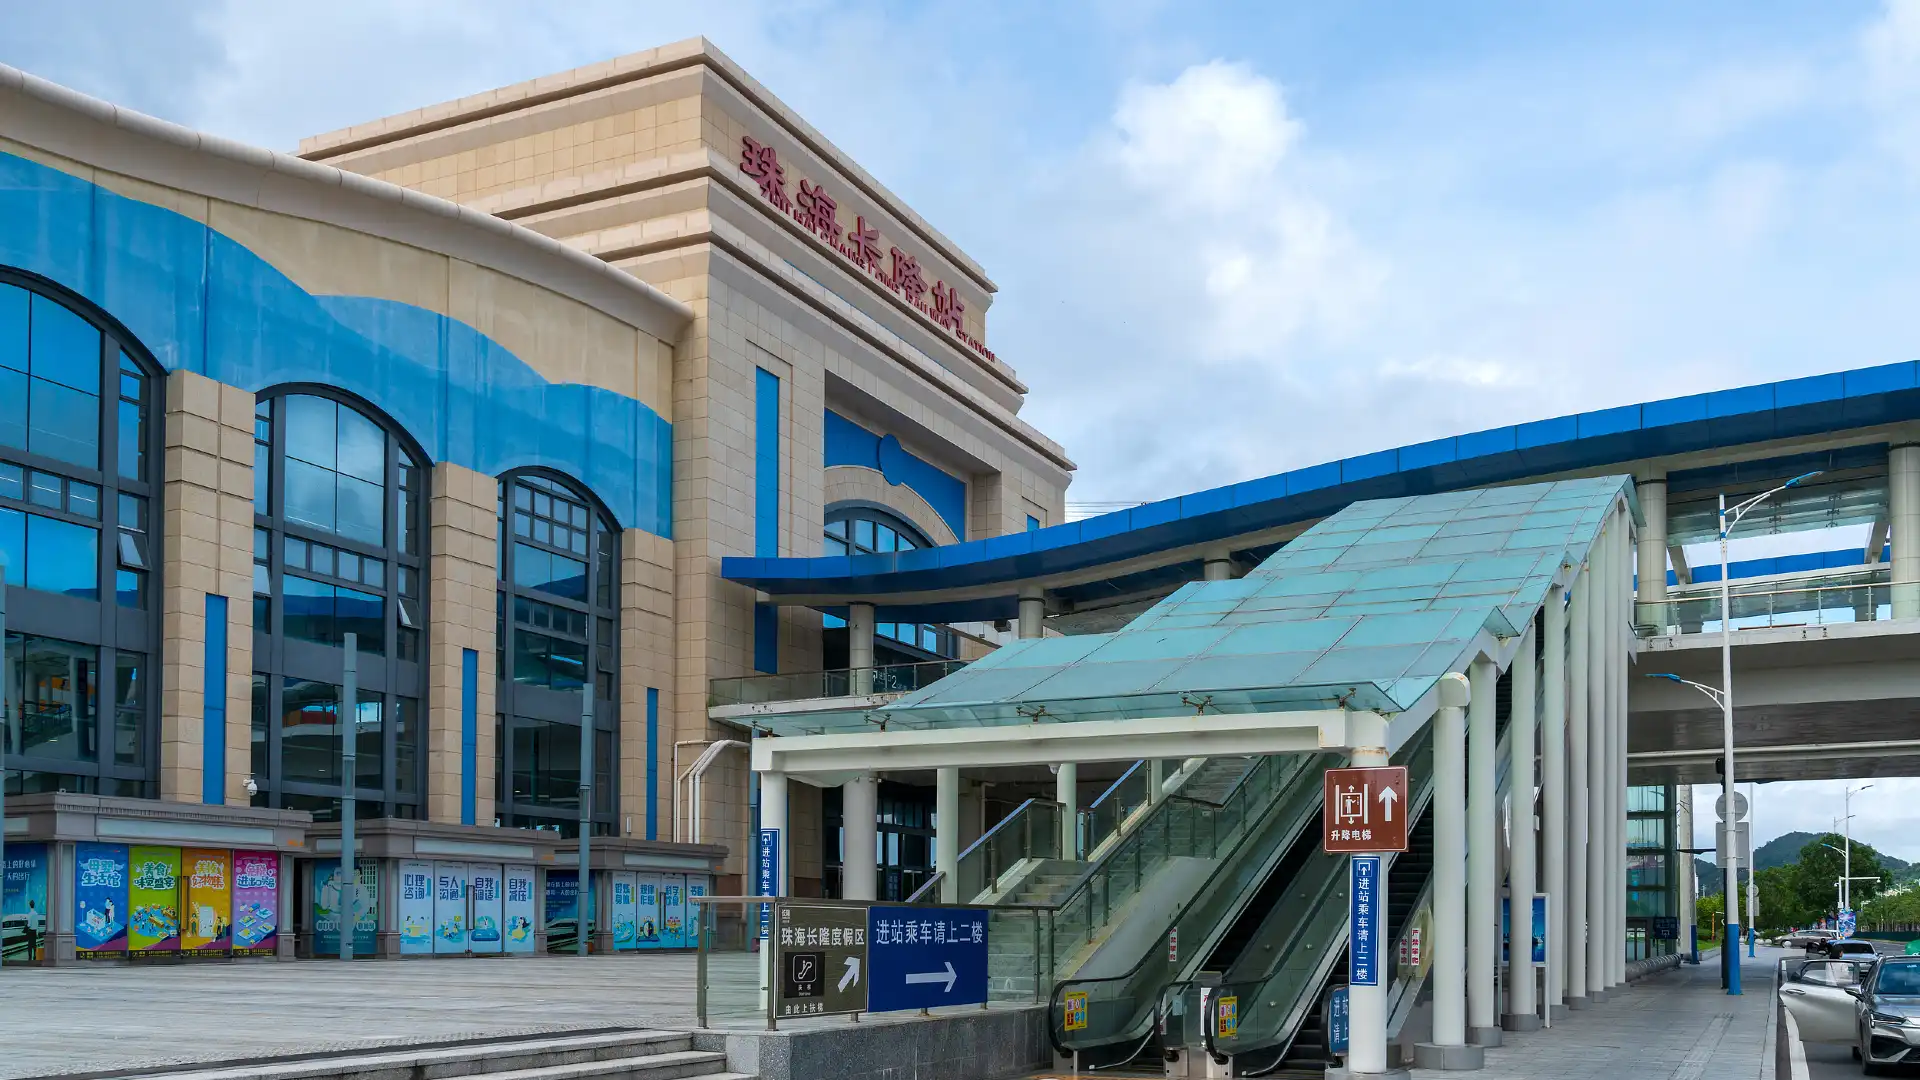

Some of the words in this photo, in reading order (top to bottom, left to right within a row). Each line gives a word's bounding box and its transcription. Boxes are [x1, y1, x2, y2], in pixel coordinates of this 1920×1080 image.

[740, 136, 965, 330] 珠海长隆站
[956, 328, 995, 363] STATION
[1331, 828, 1372, 841] 升降电梯
[143, 861, 167, 876] 美食
[81, 871, 121, 888] 生活馆
[134, 875, 175, 890] 味觉盛宴
[404, 873, 425, 886] 心理
[440, 875, 459, 888] 与人
[475, 877, 493, 889] 自我
[509, 878, 526, 890] 自我
[404, 887, 425, 900] 咨询
[440, 888, 459, 901] 沟通
[475, 889, 494, 901] 调适
[508, 890, 526, 902] 减压
[761, 847, 771, 935] 进站乘车上二楼
[781, 926, 865, 946] 珠海长隆度假区
[876, 919, 983, 945] 进站乘车请上二楼
[1356, 878, 1370, 981] 进站乘车请上二楼
[785, 1001, 824, 1015] 由此上扶梯
